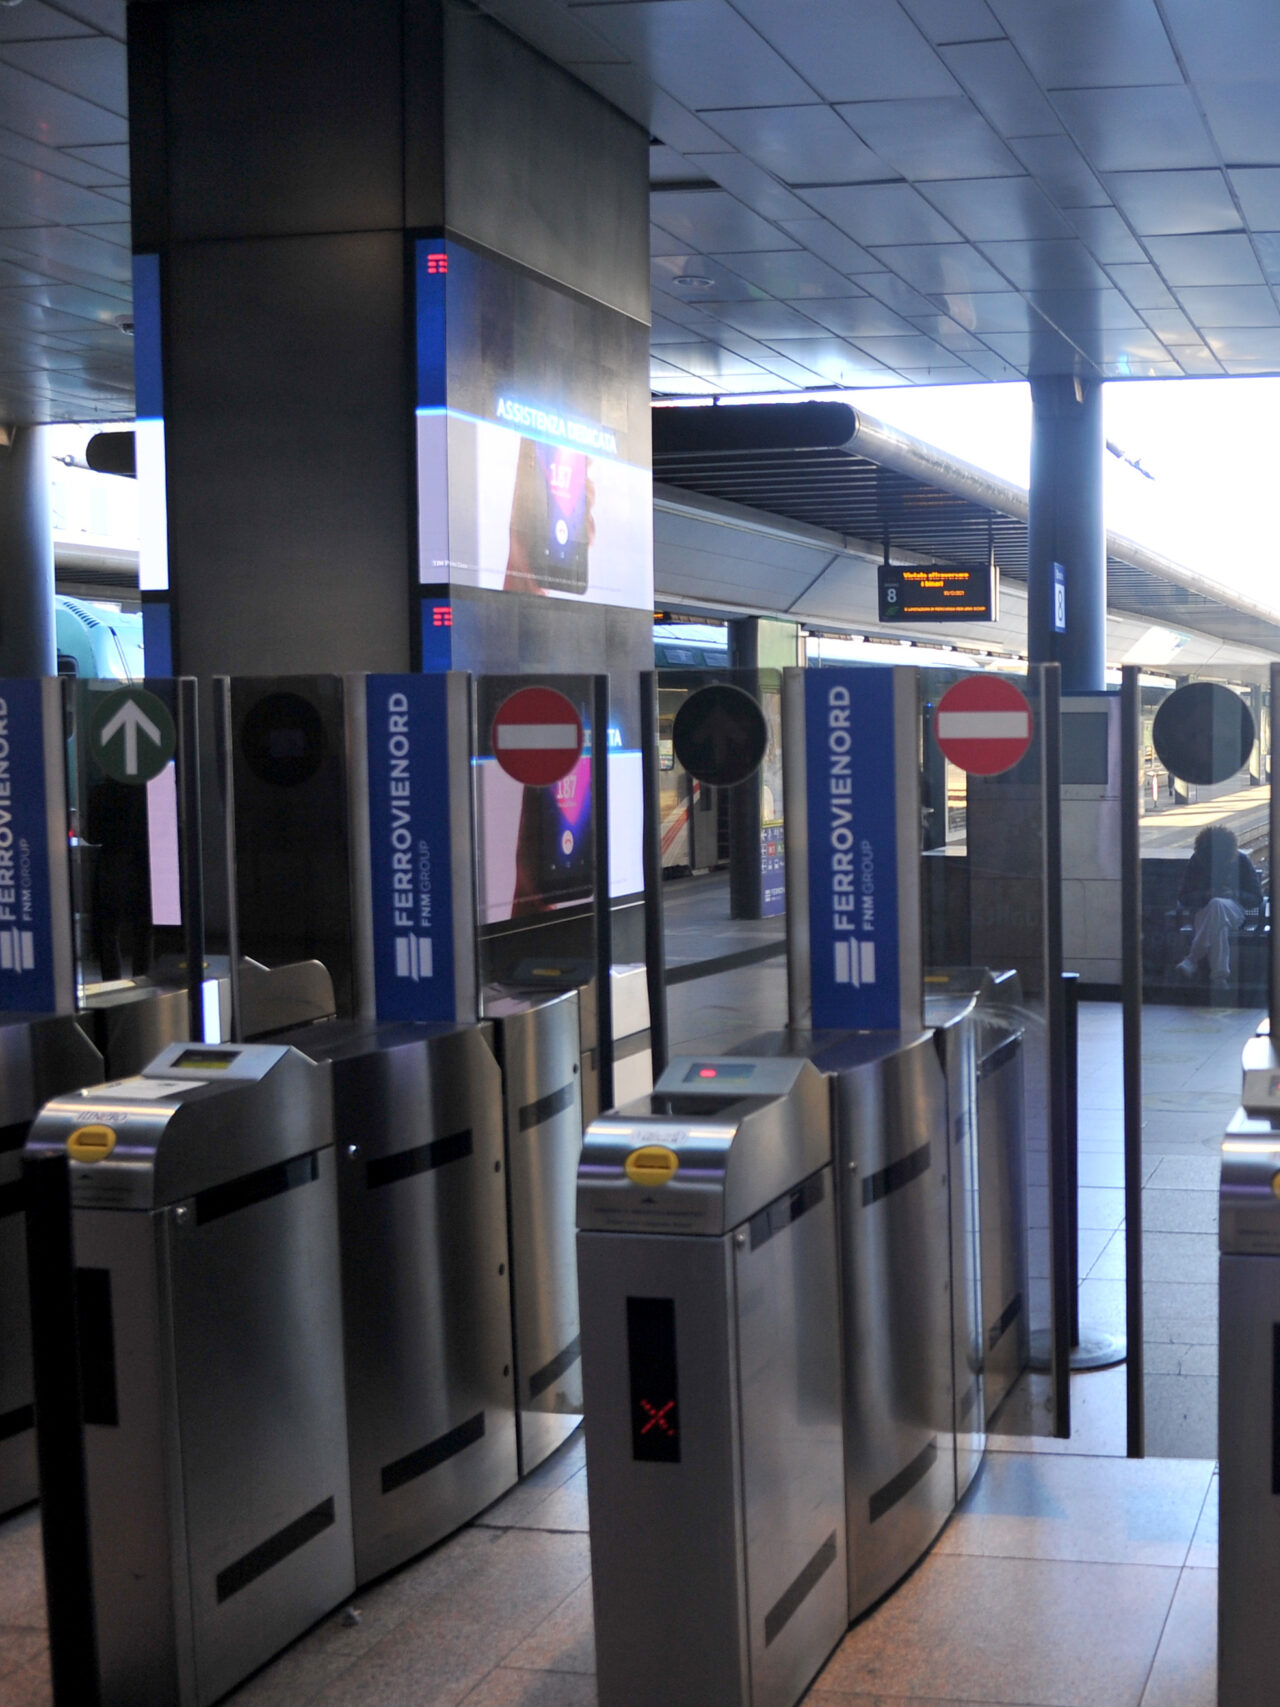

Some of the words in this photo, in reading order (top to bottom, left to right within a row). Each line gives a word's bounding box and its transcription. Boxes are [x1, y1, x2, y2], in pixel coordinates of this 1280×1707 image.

[497, 398, 566, 438] ASSISTENZA
[888, 588, 897, 603] 8
[388, 692, 414, 927] FERROVIENORD
[829, 686, 855, 930] FERROVIENORD
